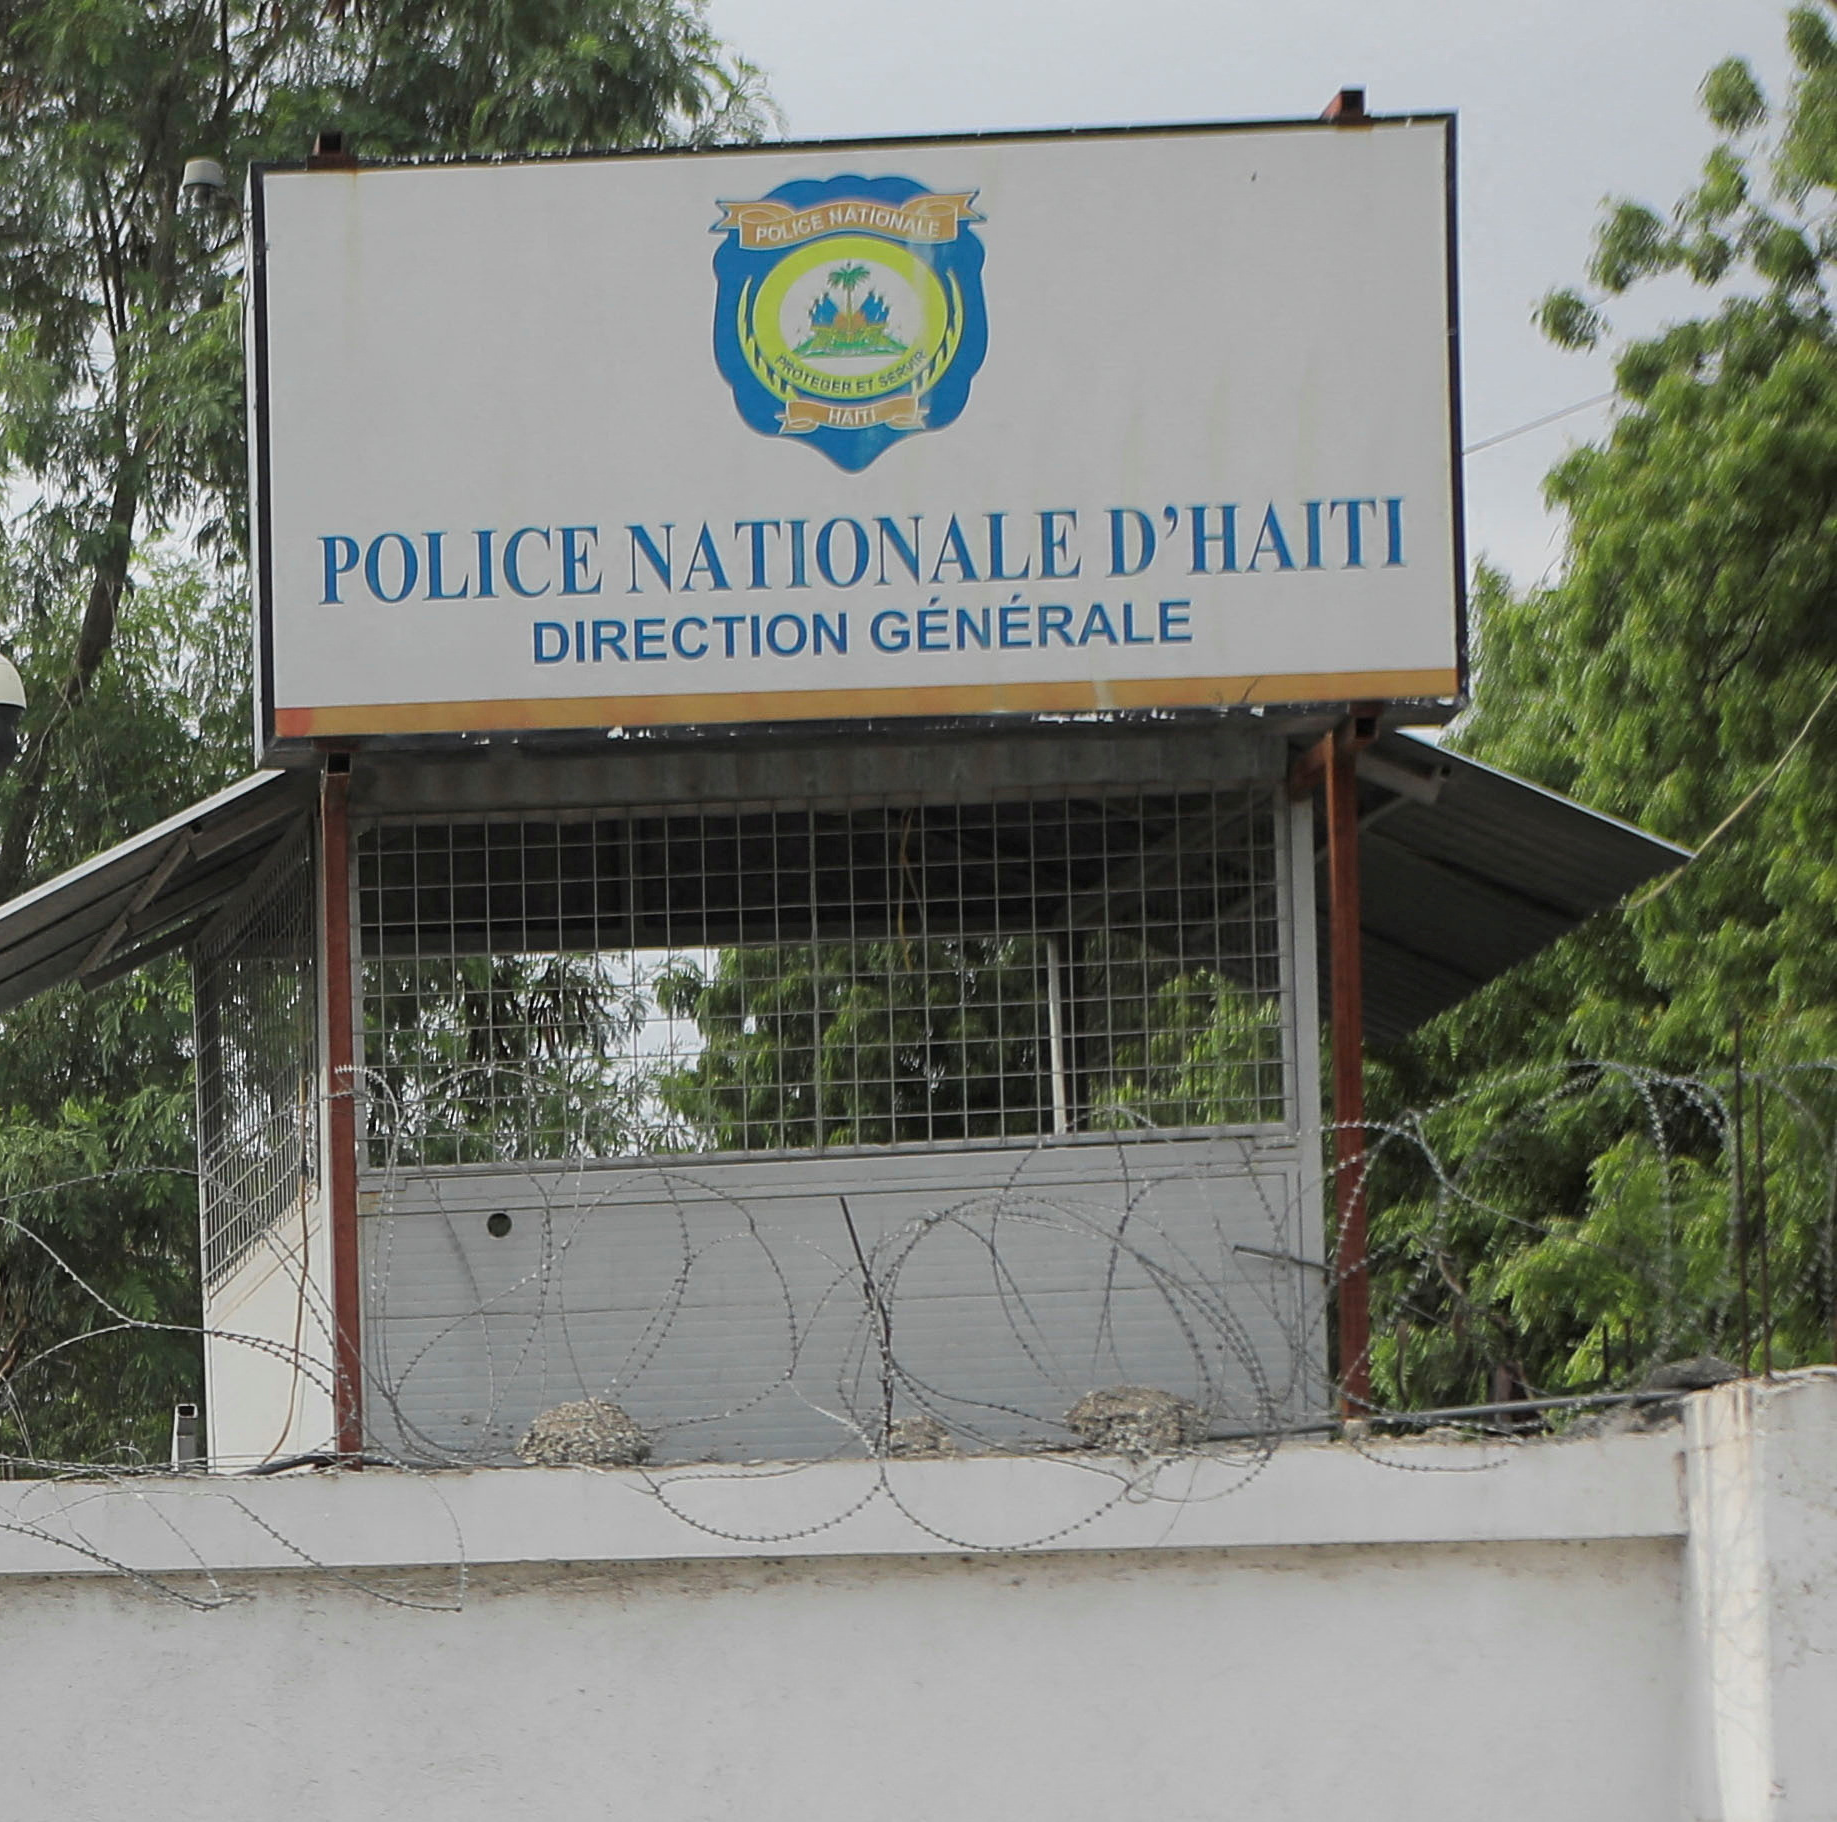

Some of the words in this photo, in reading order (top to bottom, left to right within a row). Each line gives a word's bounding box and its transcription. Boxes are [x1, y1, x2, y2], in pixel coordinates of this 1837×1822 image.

[755, 211, 825, 243] POLICE
[829, 204, 941, 239] NATIONALE
[856, 379, 874, 393] ET
[317, 523, 603, 606] POLICE
[625, 508, 1081, 594] NATIONALE
[1105, 493, 1406, 576] D’HAITI
[532, 610, 850, 665] DIRECTION
[869, 597, 1193, 655] GÉNÉRALE
